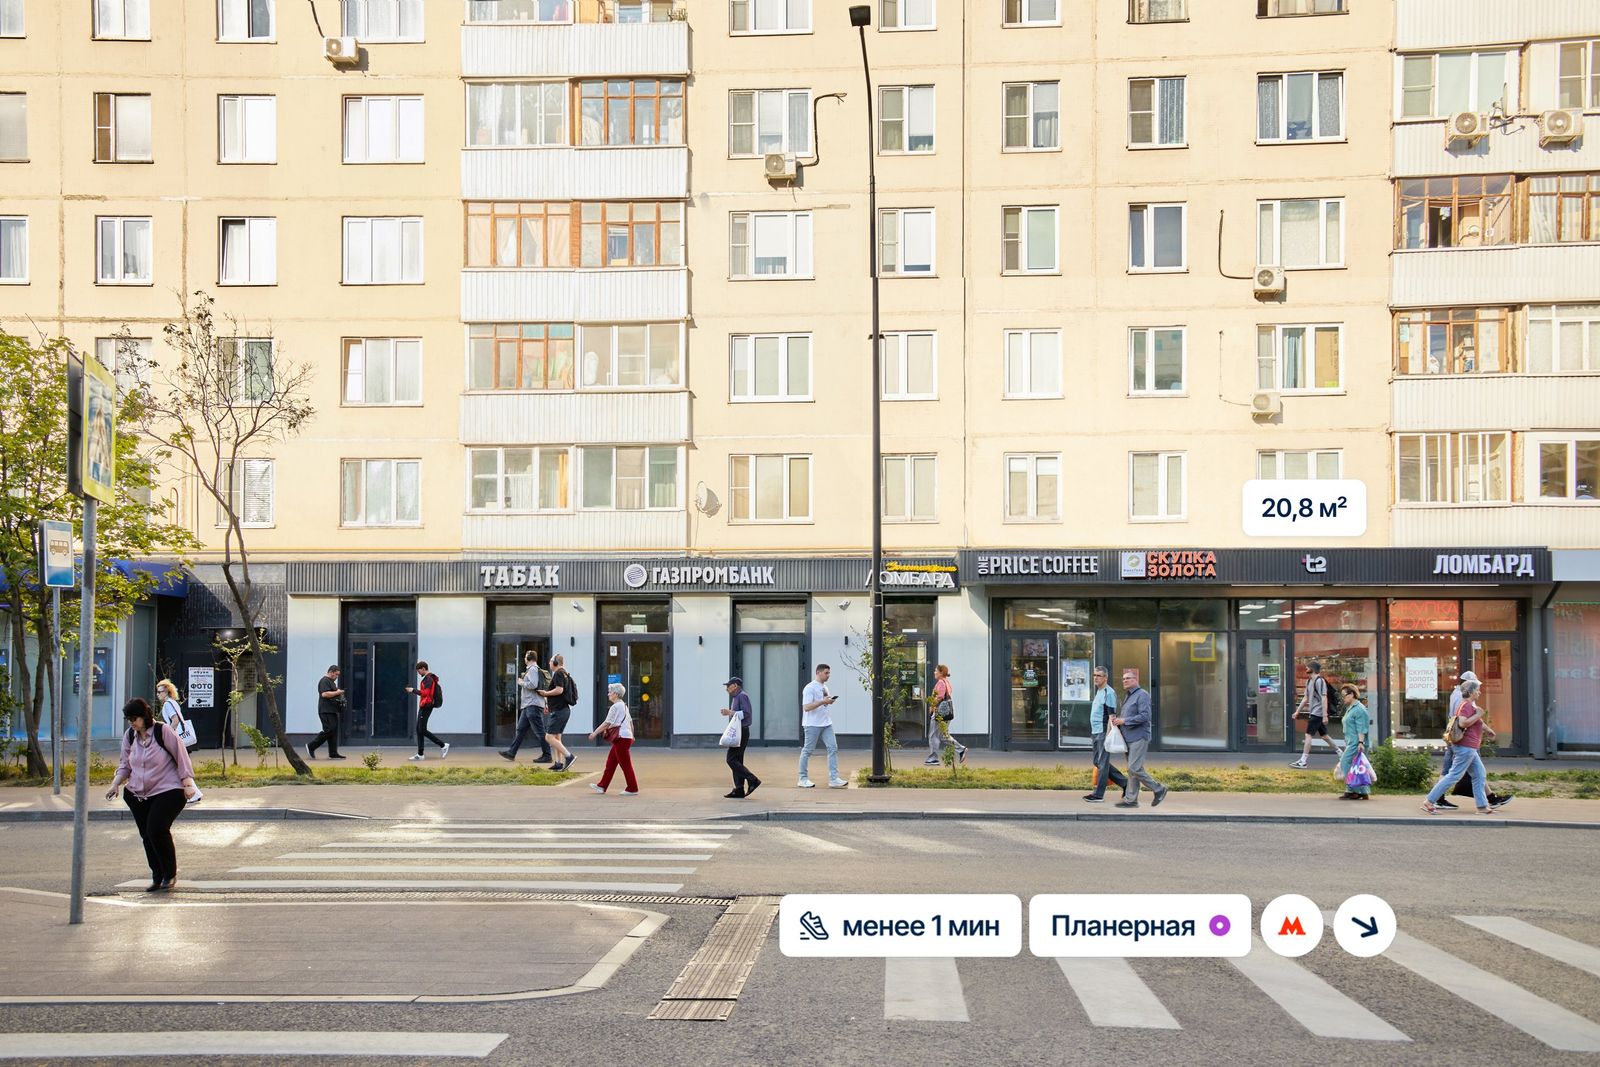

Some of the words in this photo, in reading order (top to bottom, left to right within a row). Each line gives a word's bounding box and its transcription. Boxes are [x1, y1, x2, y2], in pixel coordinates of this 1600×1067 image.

[978, 556, 989, 574] ONE
[990, 556, 1040, 575] PRICE
[1042, 556, 1099, 574] COFFEE
[1147, 551, 1217, 564] СКУПКА
[1433, 554, 1535, 577] ЛОМБАРД
[480, 565, 560, 588] ТАБАК
[652, 566, 776, 585] ГАЗПРОМБАНК
[1147, 564, 1217, 577] ЗОЛОТА
